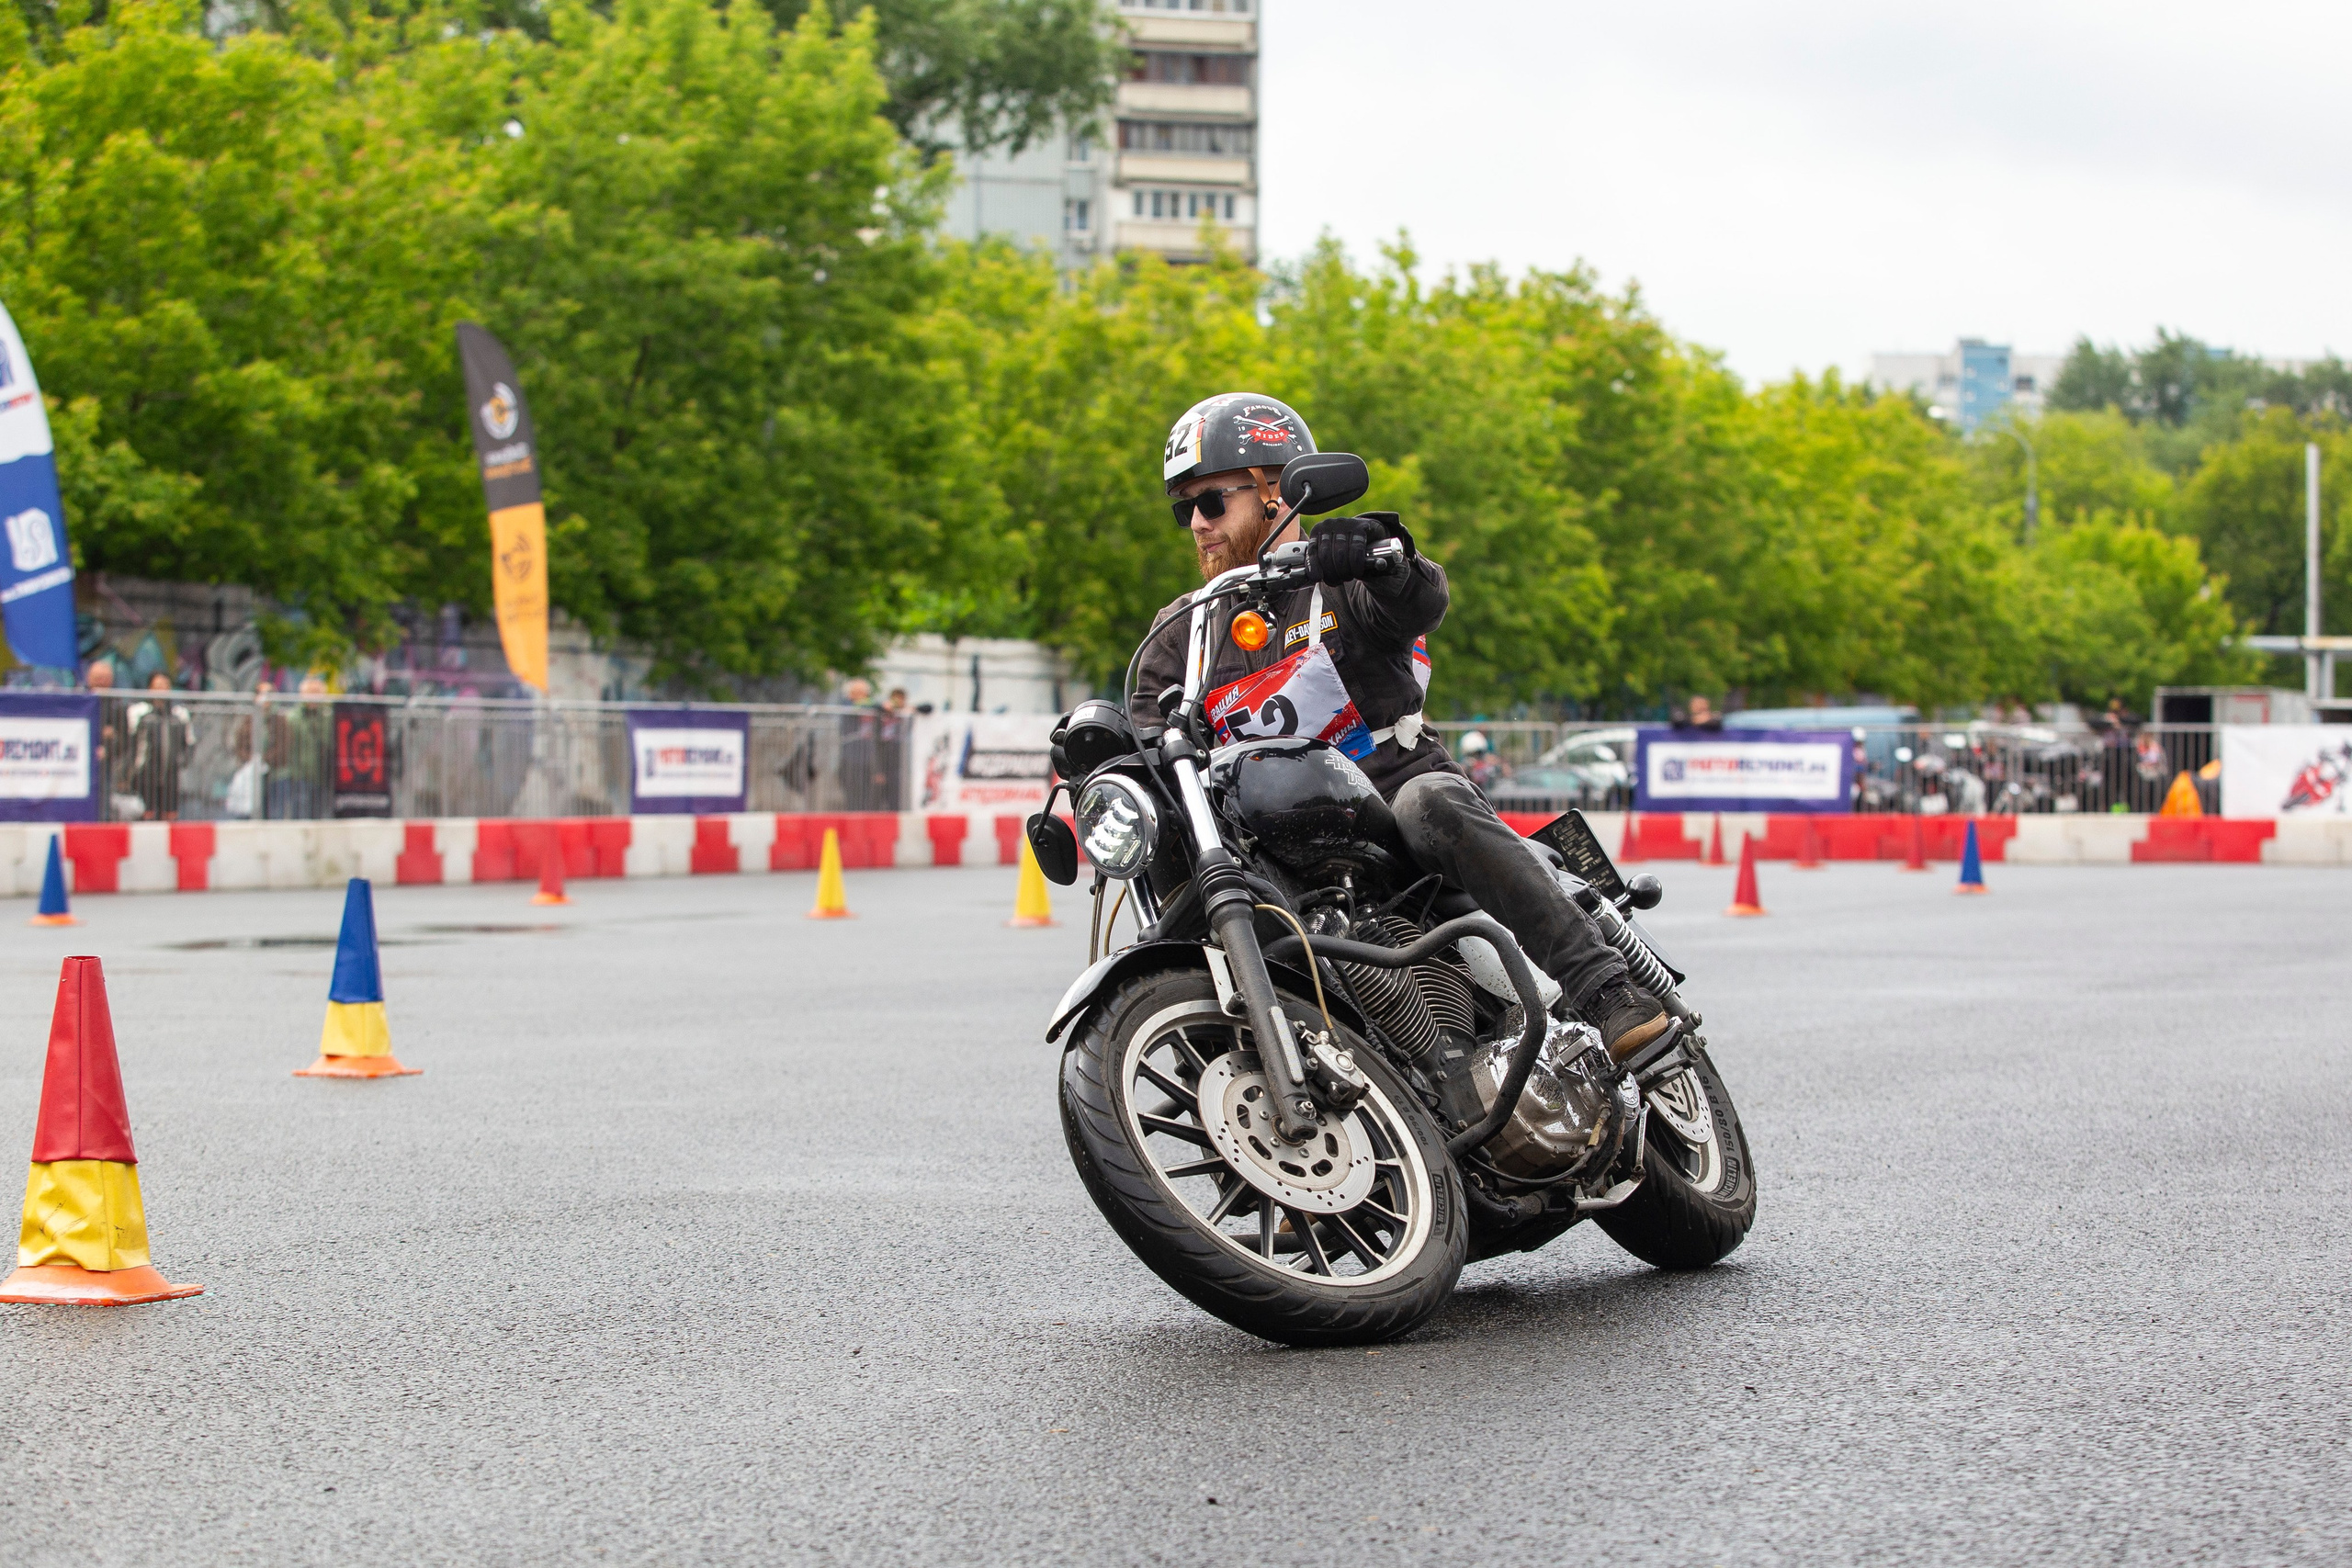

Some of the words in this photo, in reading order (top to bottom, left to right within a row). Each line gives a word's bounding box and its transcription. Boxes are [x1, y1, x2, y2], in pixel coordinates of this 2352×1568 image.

[1243, 404, 1282, 417] FAMOUS
[1255, 431, 1285, 439] RIDER
[1701, 1076, 1713, 1090] 16
[1709, 1096, 1719, 1105] B
[1714, 1110, 1735, 1152] 150/80
[1722, 1158, 1738, 1200] MICHELIN
[1433, 1174, 1445, 1224] MICHELIN
